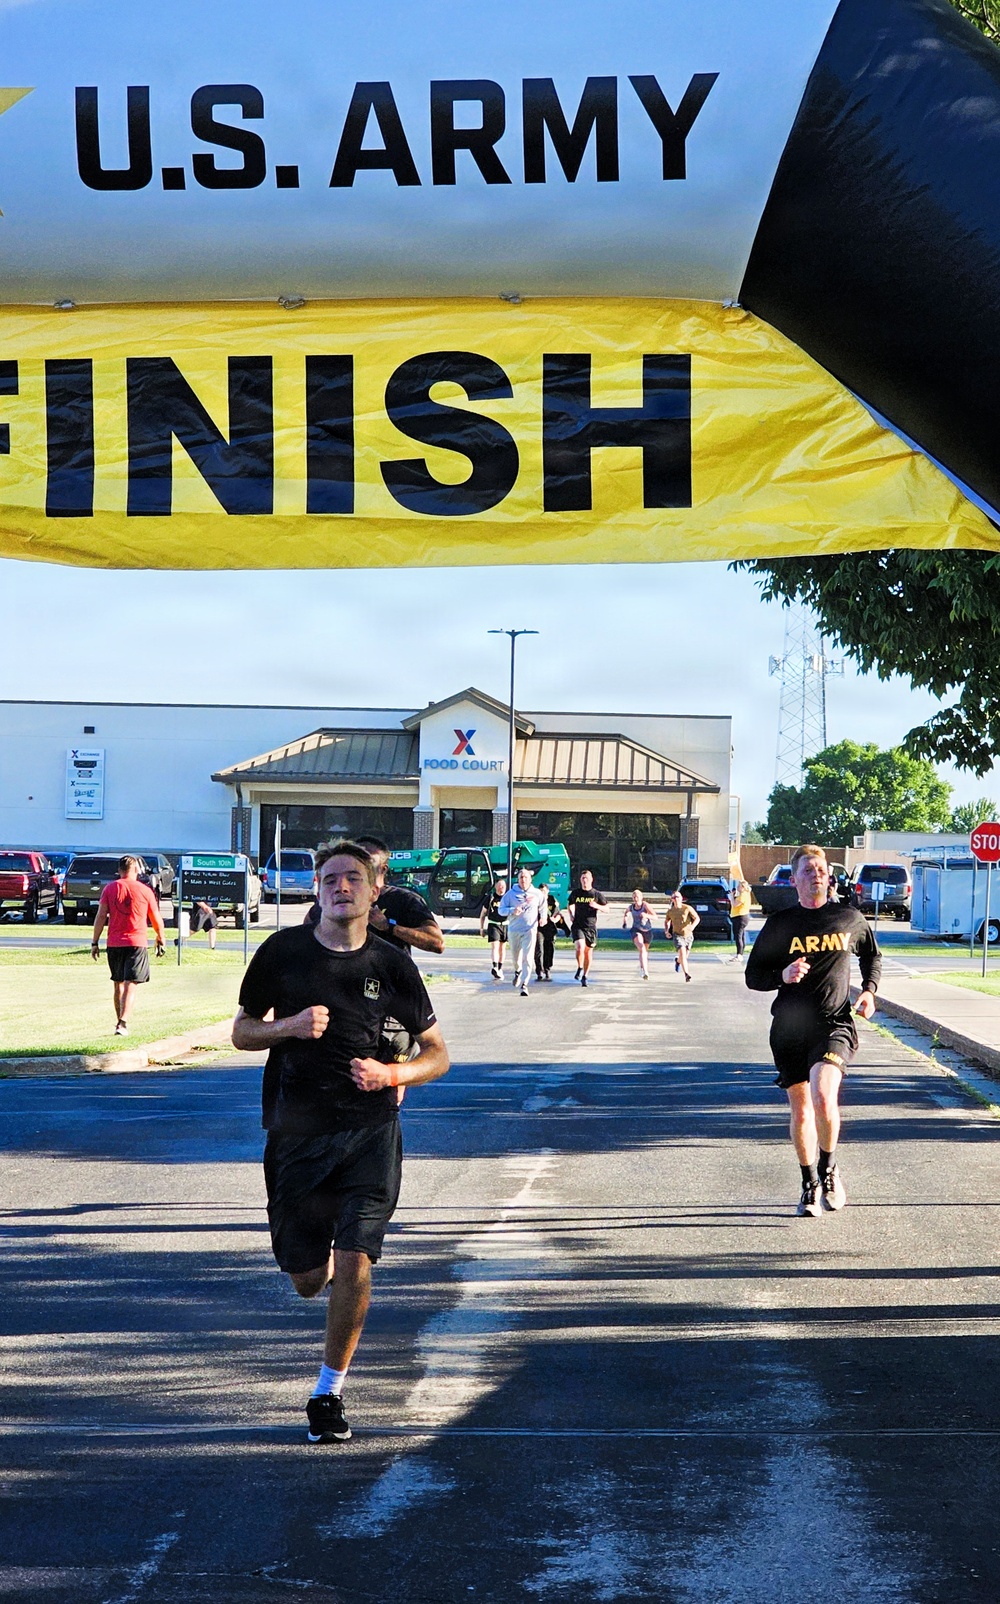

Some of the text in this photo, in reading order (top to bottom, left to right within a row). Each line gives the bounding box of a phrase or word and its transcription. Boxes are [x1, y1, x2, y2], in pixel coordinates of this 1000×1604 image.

[75, 72, 720, 190] U.S. ARMY
[424, 759, 504, 771] FOOD COURT
[972, 834, 1000, 850] STO
[388, 852, 412, 860] JCB
[789, 933, 852, 955] ARMY
